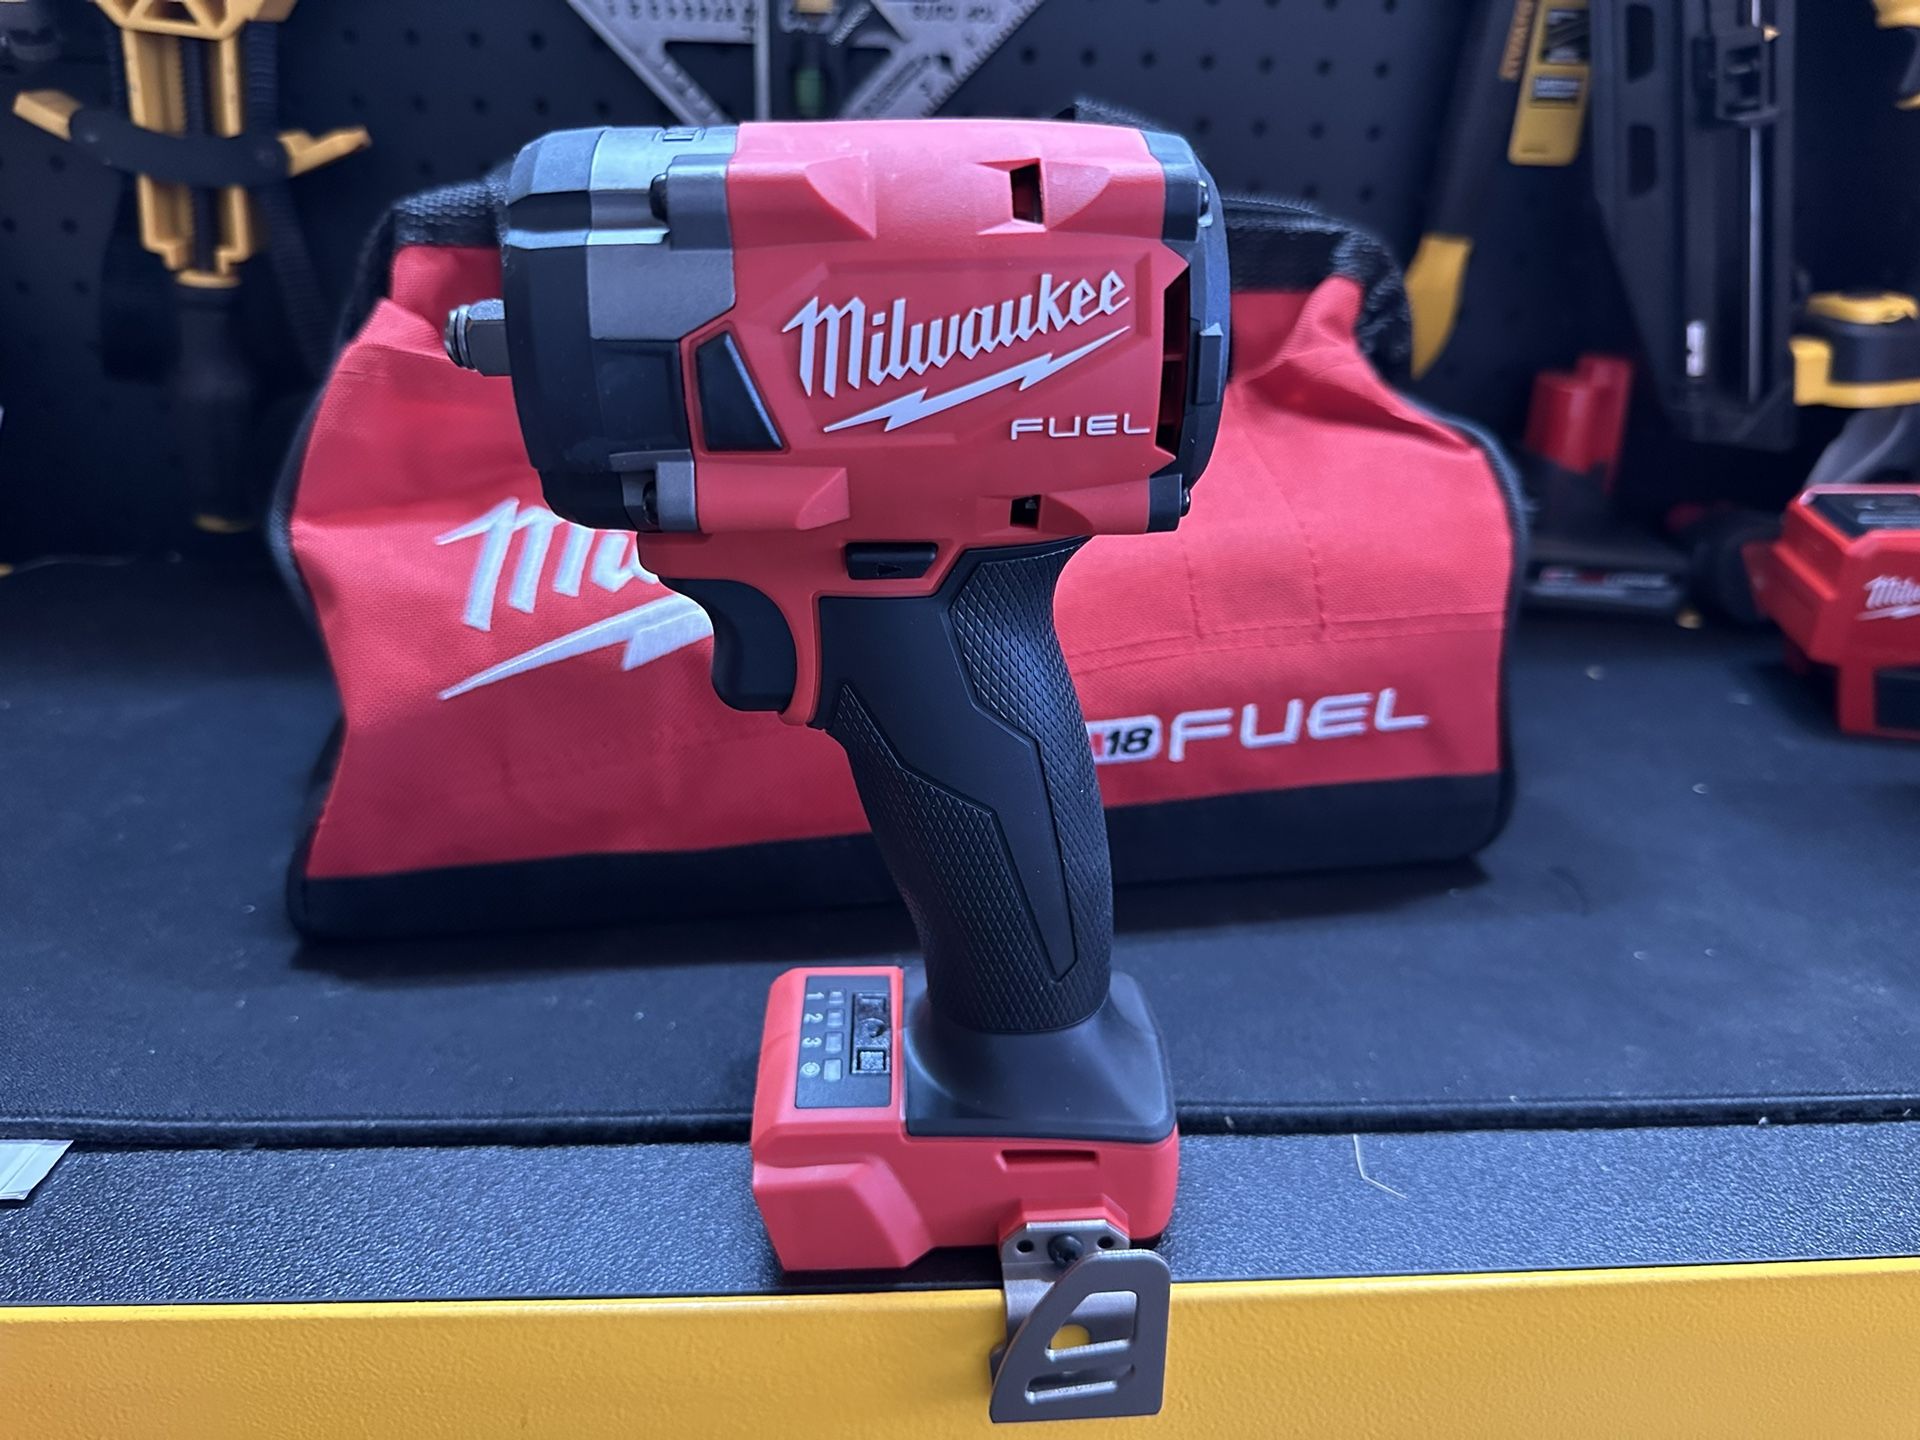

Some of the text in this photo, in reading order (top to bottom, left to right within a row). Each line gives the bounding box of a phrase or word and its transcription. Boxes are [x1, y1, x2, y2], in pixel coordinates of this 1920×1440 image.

[782, 270, 1130, 398] Milwaukee
[1010, 413, 1151, 440] FUEL
[1168, 687, 1431, 763] FUEL
[806, 992, 825, 1000] 1
[803, 1013, 824, 1024] 2
[802, 1037, 823, 1048] 3
